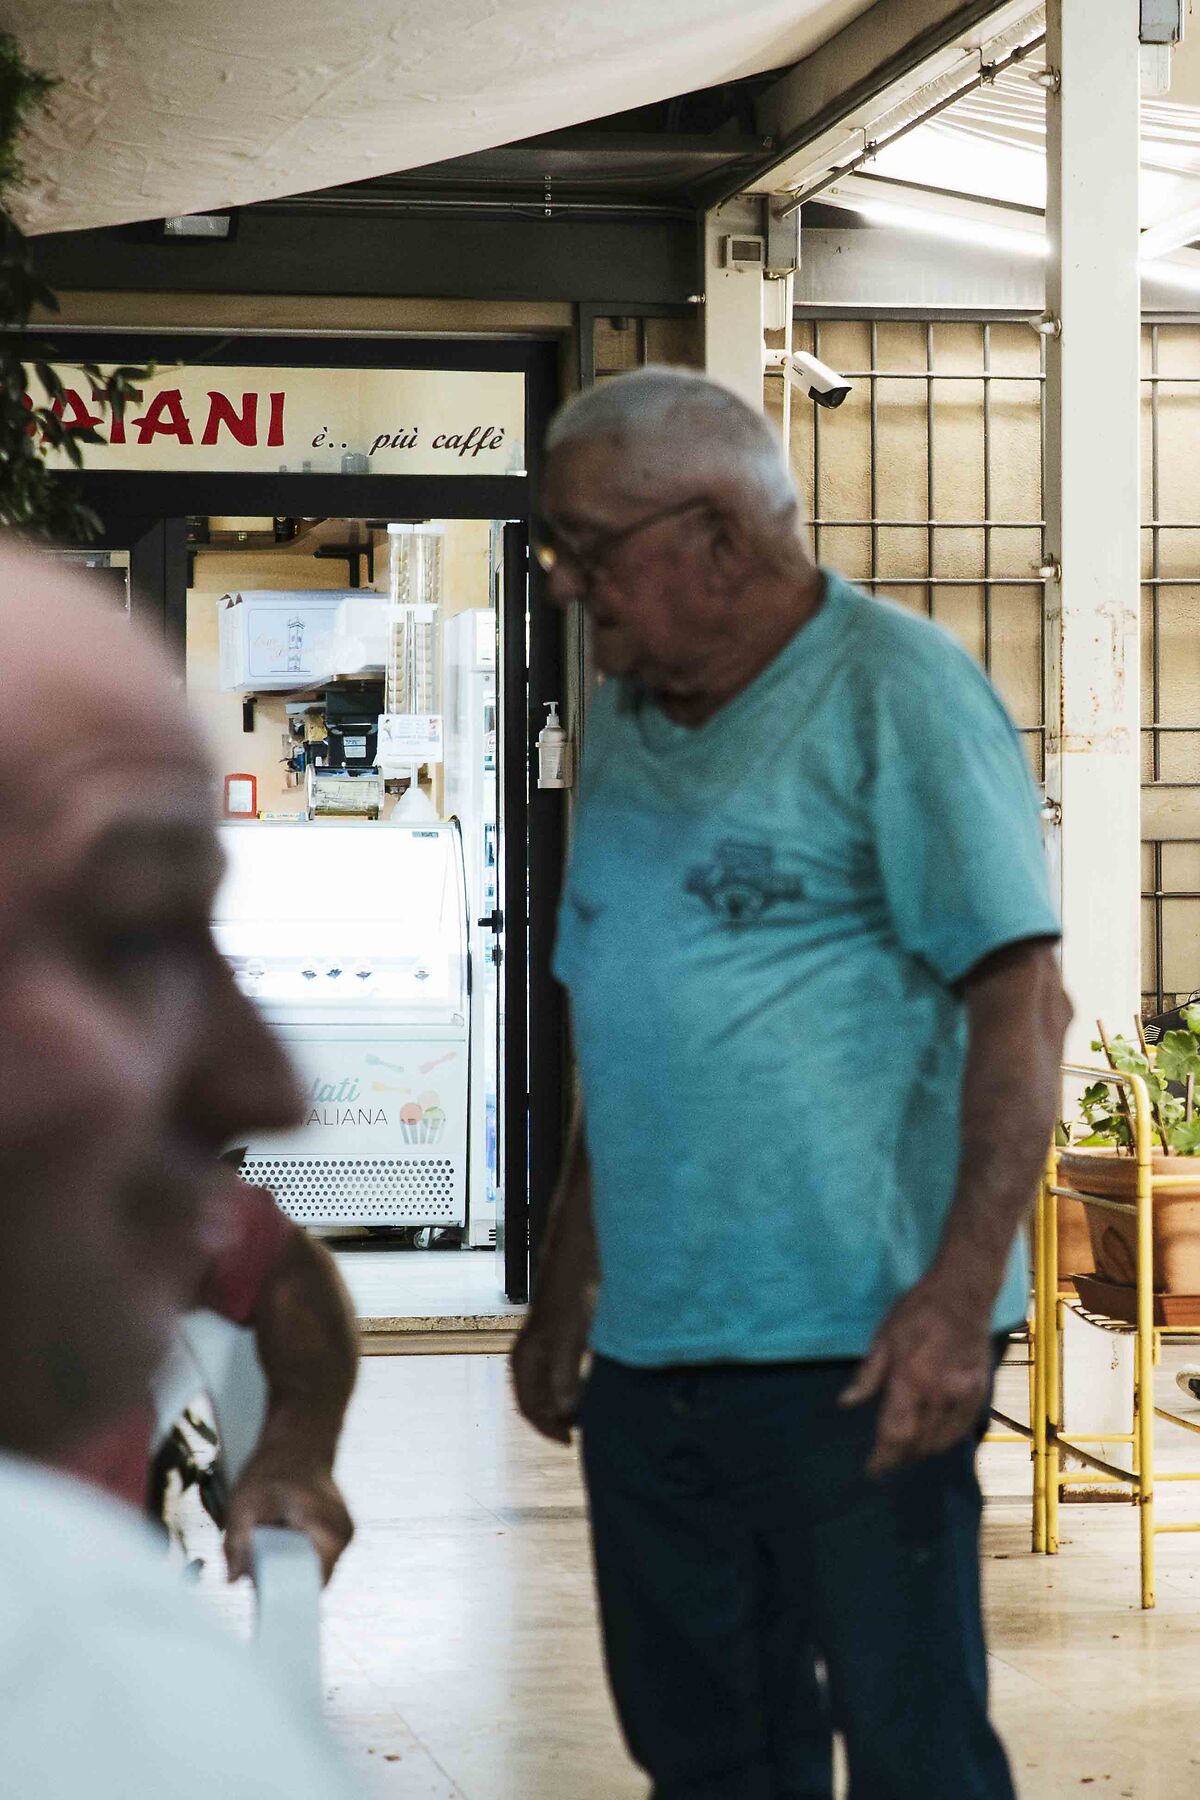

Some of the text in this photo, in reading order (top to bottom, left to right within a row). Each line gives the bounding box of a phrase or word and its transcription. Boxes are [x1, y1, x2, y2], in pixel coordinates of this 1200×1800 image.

[369, 427, 419, 456] più
[432, 426, 506, 457] caffè
[309, 1077, 360, 1104] lati
[304, 1108, 388, 1126] ALIANA
